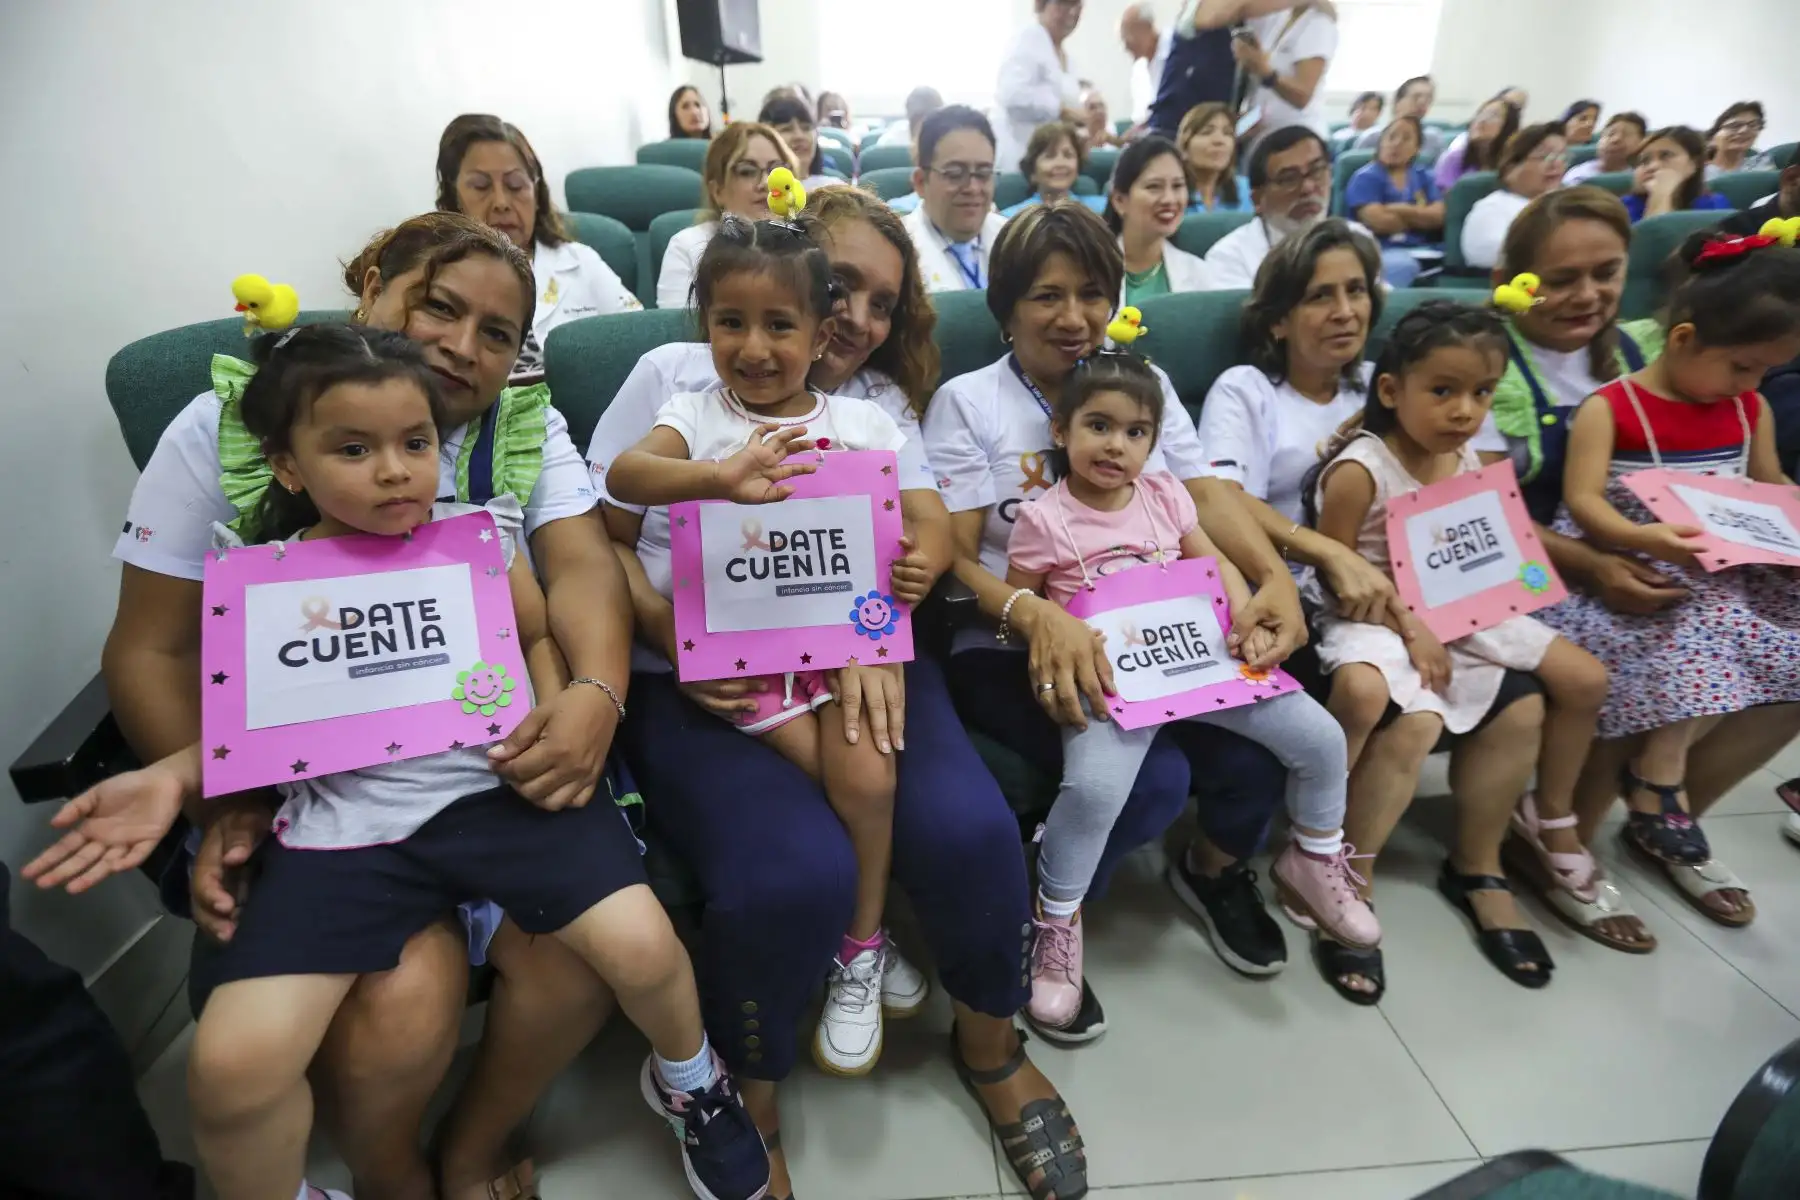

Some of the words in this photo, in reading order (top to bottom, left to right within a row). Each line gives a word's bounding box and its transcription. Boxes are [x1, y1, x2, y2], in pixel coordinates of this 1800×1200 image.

[769, 528, 847, 559] DATE
[1446, 517, 1492, 543] DATE
[1427, 533, 1499, 569] CUENTA
[725, 553, 851, 582] CUENTA
[781, 587, 810, 595] infancia
[339, 598, 442, 638] DATE
[278, 624, 447, 668] CUENTA
[1142, 621, 1202, 649] DATE
[355, 663, 394, 676] infancia
[397, 661, 411, 669] sin
[1117, 641, 1211, 672] CUENTA
